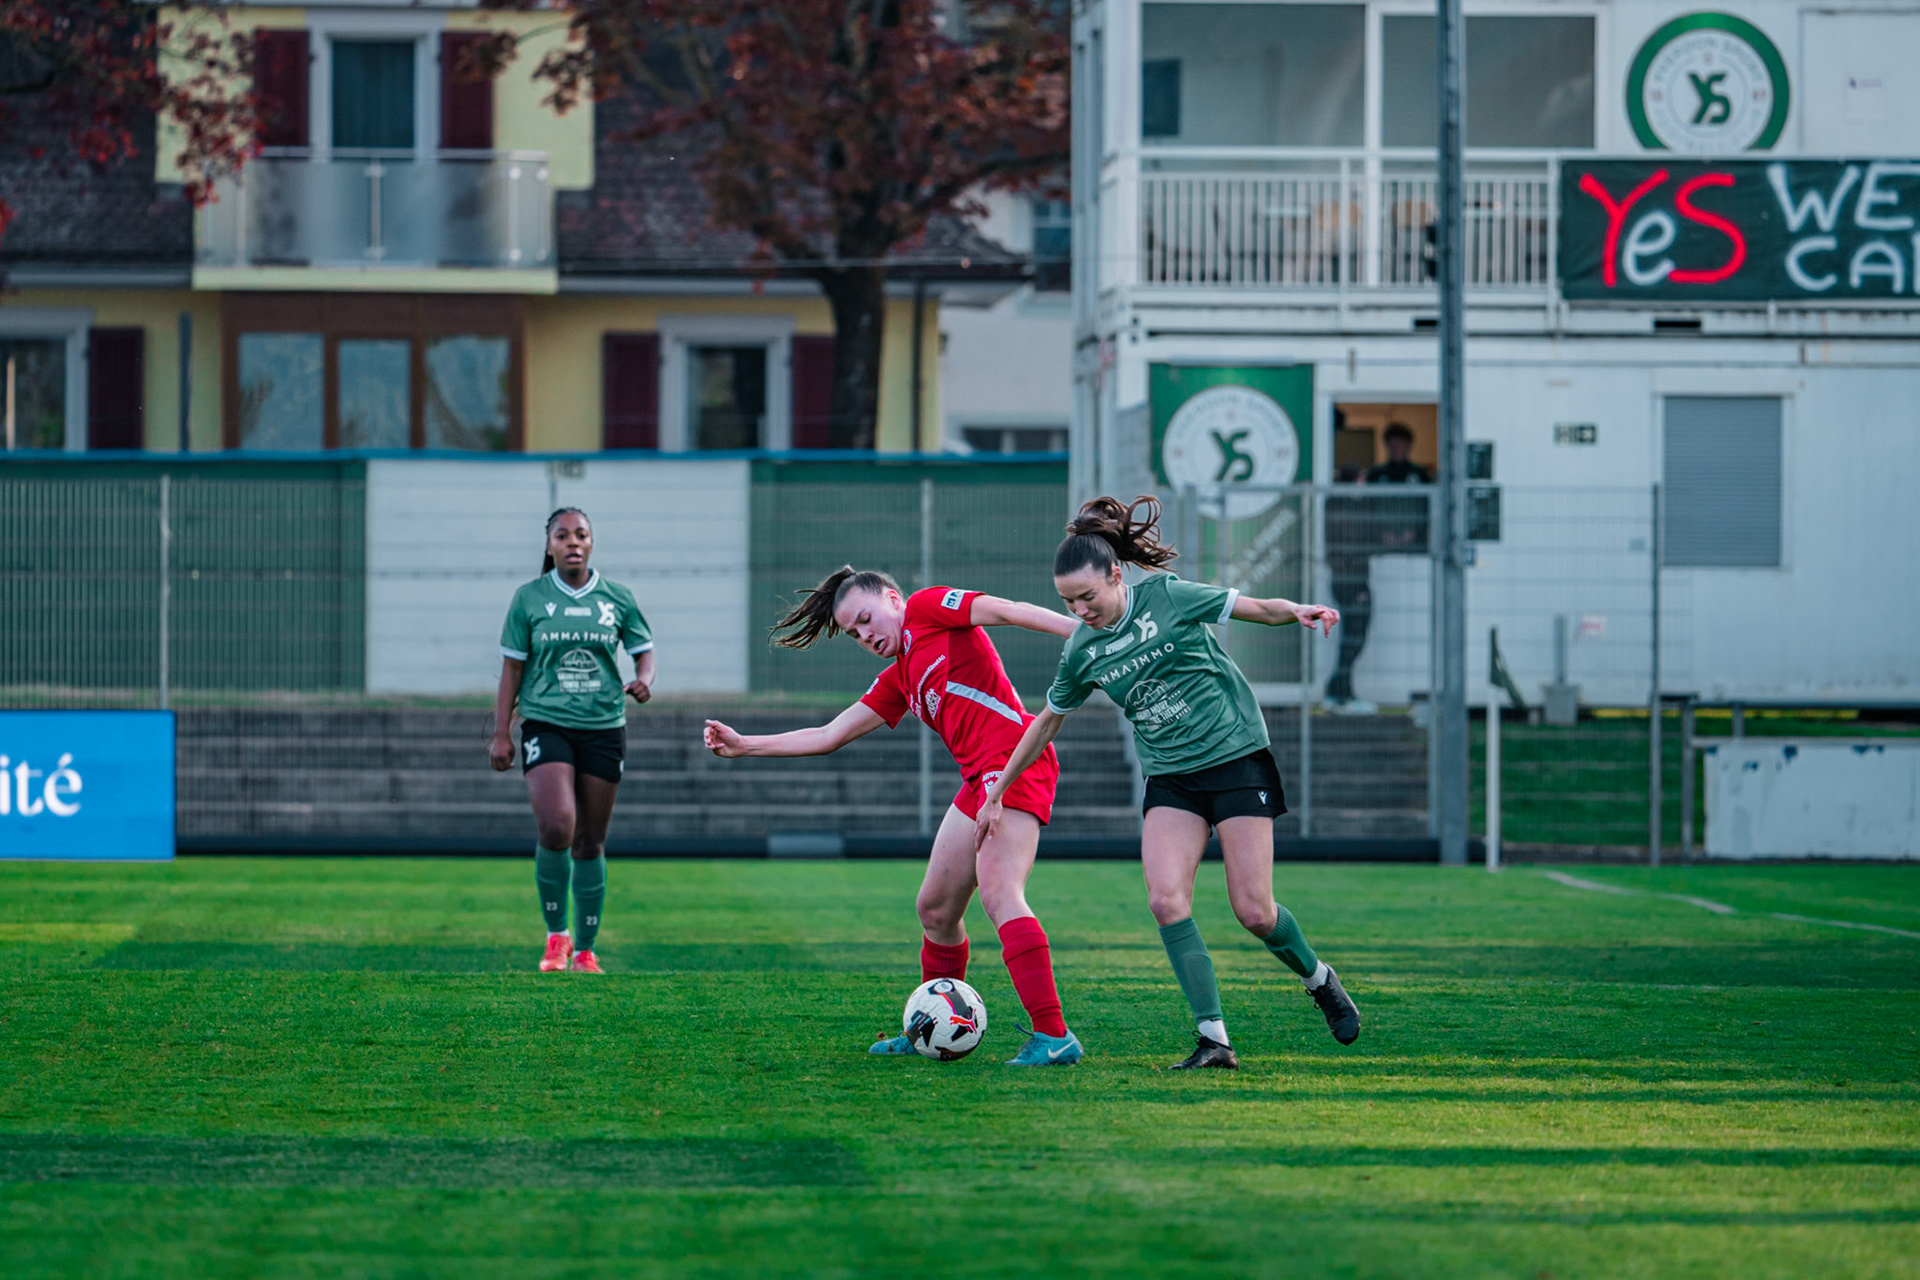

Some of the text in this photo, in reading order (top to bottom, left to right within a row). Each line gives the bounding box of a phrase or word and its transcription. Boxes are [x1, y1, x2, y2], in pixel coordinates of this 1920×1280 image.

[1766, 163, 1920, 232] WE
[545, 902, 558, 911] 23
[586, 916, 598, 926] 23
